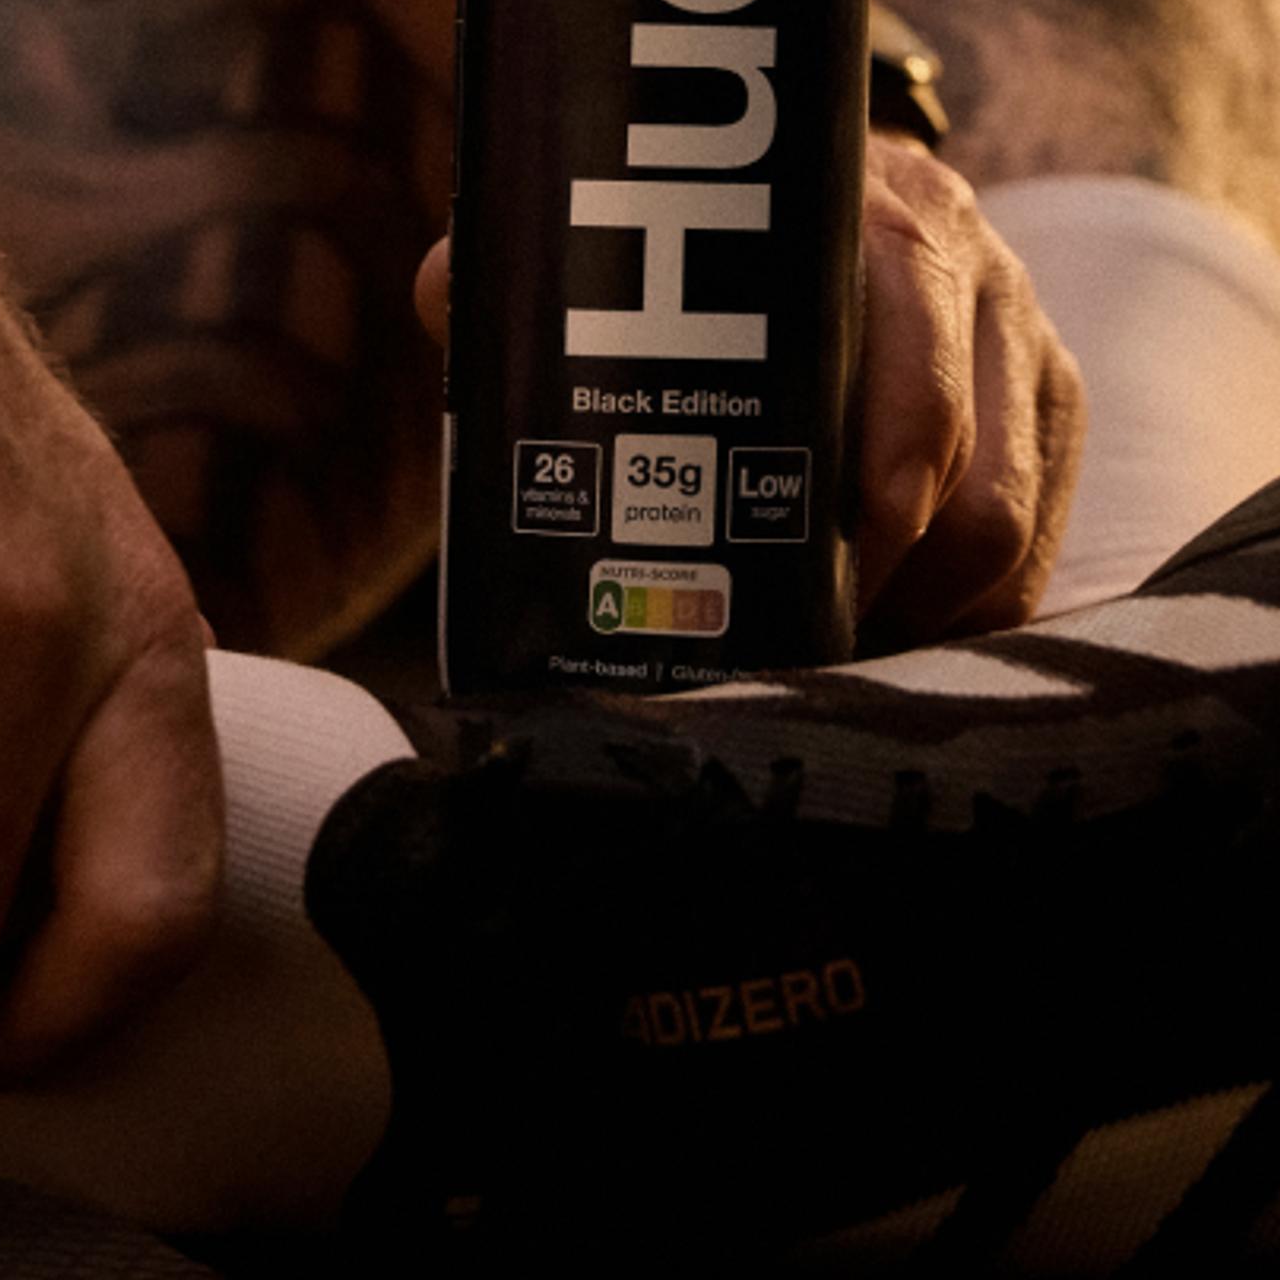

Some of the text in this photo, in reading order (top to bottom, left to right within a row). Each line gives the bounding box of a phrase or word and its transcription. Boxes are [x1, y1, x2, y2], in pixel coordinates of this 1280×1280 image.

[572, 387, 762, 417] Black Edition
[534, 452, 575, 484] 26
[628, 456, 702, 495] 35g
[739, 467, 802, 500] Low
[577, 490, 590, 505] &
[624, 503, 702, 523] protein
[600, 567, 698, 581] NUTRI-SCORE
[596, 592, 618, 618] A
[548, 655, 647, 678] Plant-based
